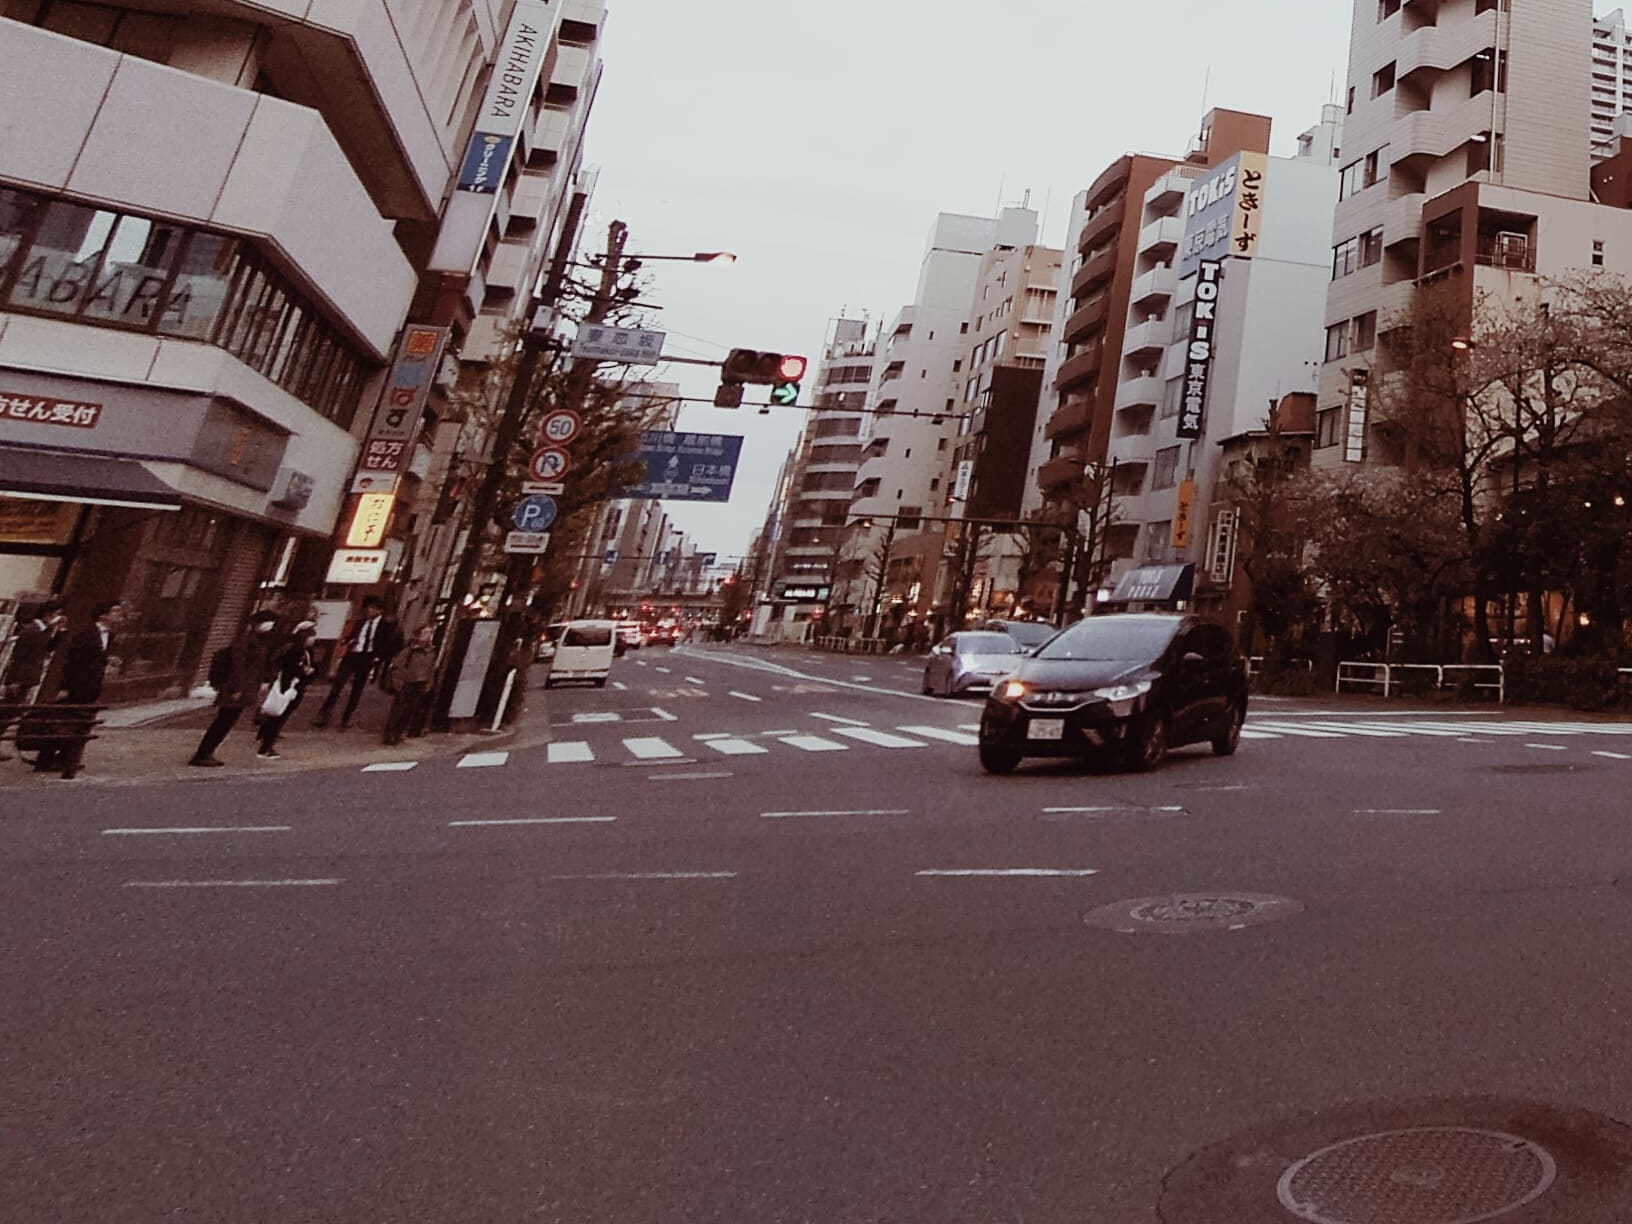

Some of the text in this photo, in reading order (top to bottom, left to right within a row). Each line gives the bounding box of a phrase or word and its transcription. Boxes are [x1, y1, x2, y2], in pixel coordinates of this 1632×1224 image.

[491, 23, 537, 118] AKIHABARA
[1234, 169, 1262, 252] ときーず
[549, 419, 572, 436] 50
